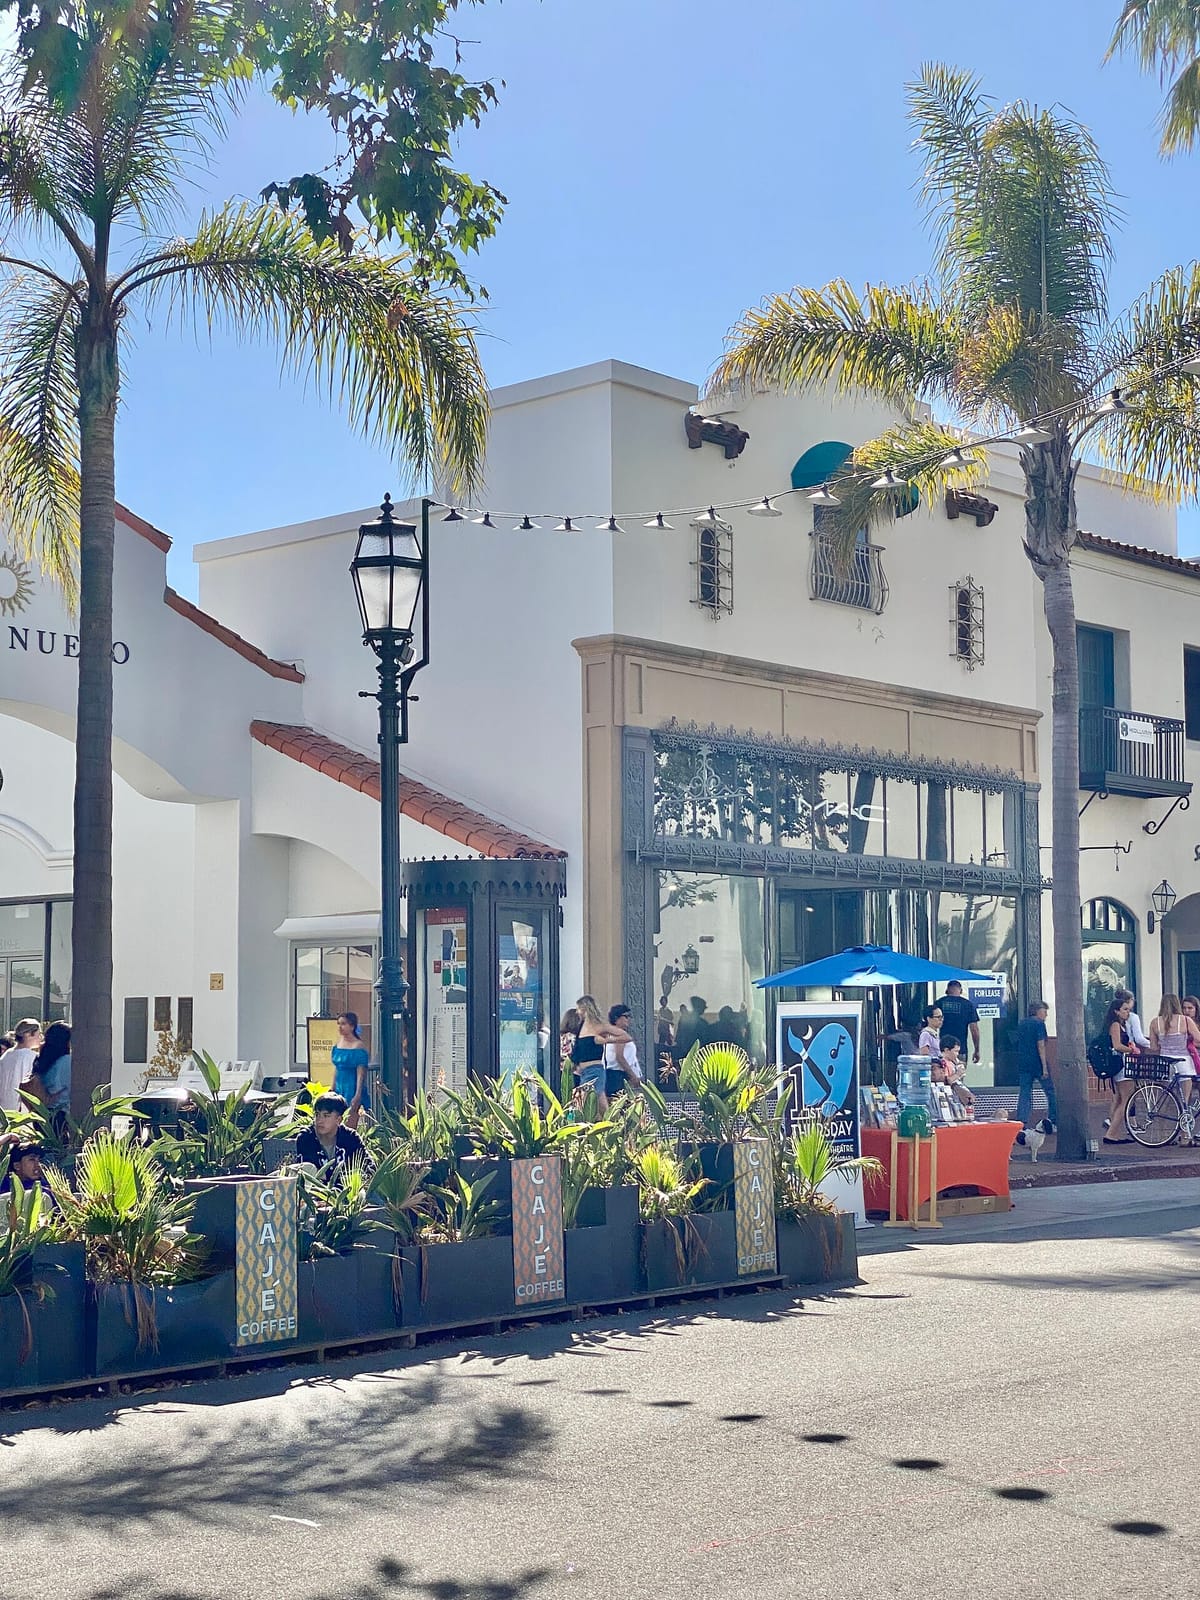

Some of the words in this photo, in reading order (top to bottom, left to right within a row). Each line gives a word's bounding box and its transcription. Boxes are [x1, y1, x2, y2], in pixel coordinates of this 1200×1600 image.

[8, 625, 130, 665] NUEO
[974, 989, 986, 998] FOR
[986, 989, 1001, 997] LEASE
[739, 1251, 776, 1267] COFFEE
[516, 1279, 564, 1297] COFFEE
[239, 1316, 296, 1337] COFFEE
